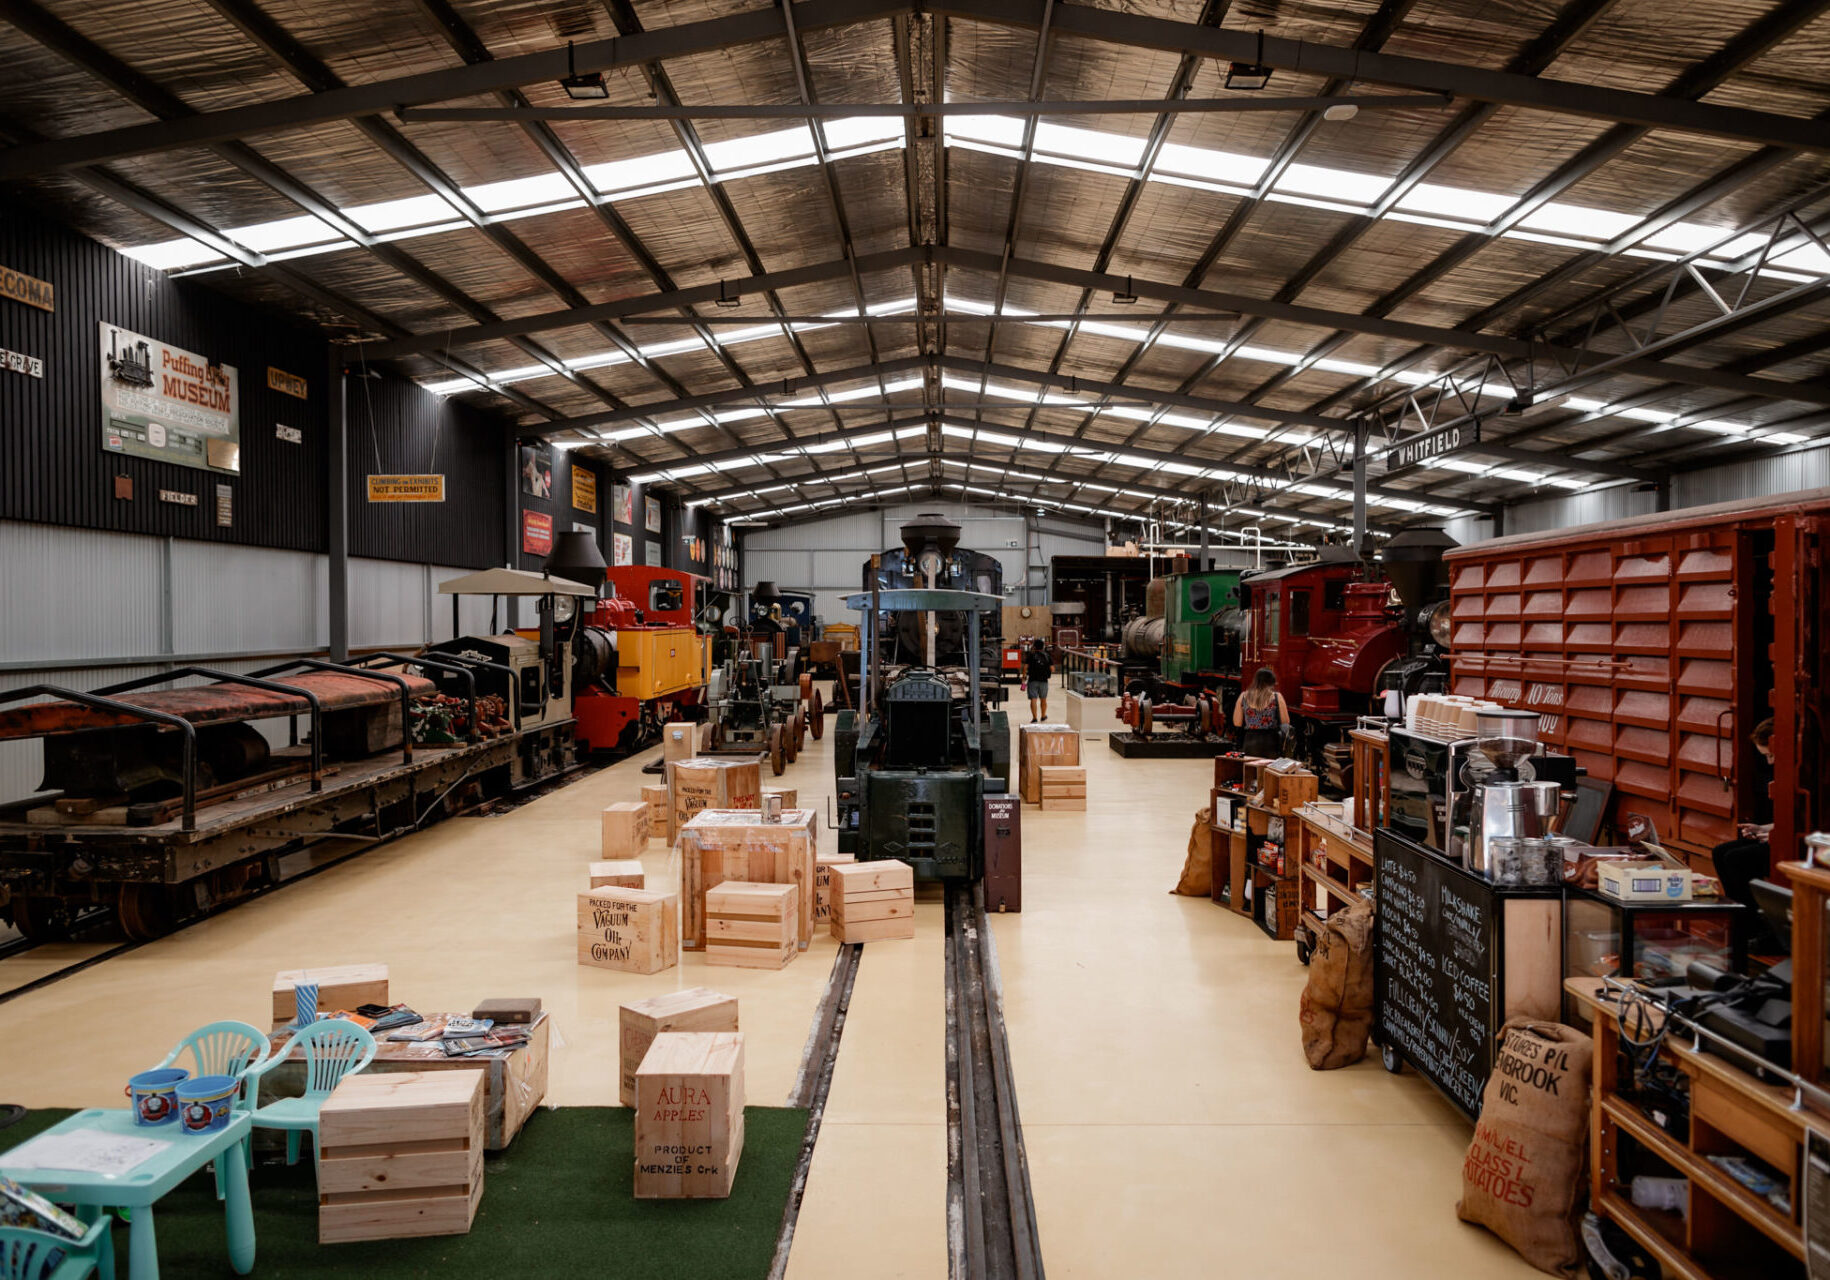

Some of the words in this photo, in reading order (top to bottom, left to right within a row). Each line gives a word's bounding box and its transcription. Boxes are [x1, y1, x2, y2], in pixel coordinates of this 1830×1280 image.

[162, 348, 205, 385] Puffing
[163, 374, 231, 413] MUSEUM
[1399, 428, 1460, 465] WHITFIELD
[1527, 684, 1542, 705] 10
[1541, 685, 1564, 706] Tons
[589, 899, 611, 910] PACKED
[612, 901, 625, 911] FOR
[626, 903, 637, 912] THE
[593, 909, 629, 929] VACUUM
[591, 940, 632, 962] COMPANY
[1459, 970, 1490, 1003] COFFEE
[656, 1087, 711, 1105] AURA
[653, 1109, 705, 1121] APPLES
[654, 1145, 712, 1155] PRODUCT
[674, 1155, 690, 1164] OF
[1471, 1143, 1512, 1177] CLASS
[640, 1164, 692, 1175] MENZIES
[697, 1164, 719, 1175] Crk
